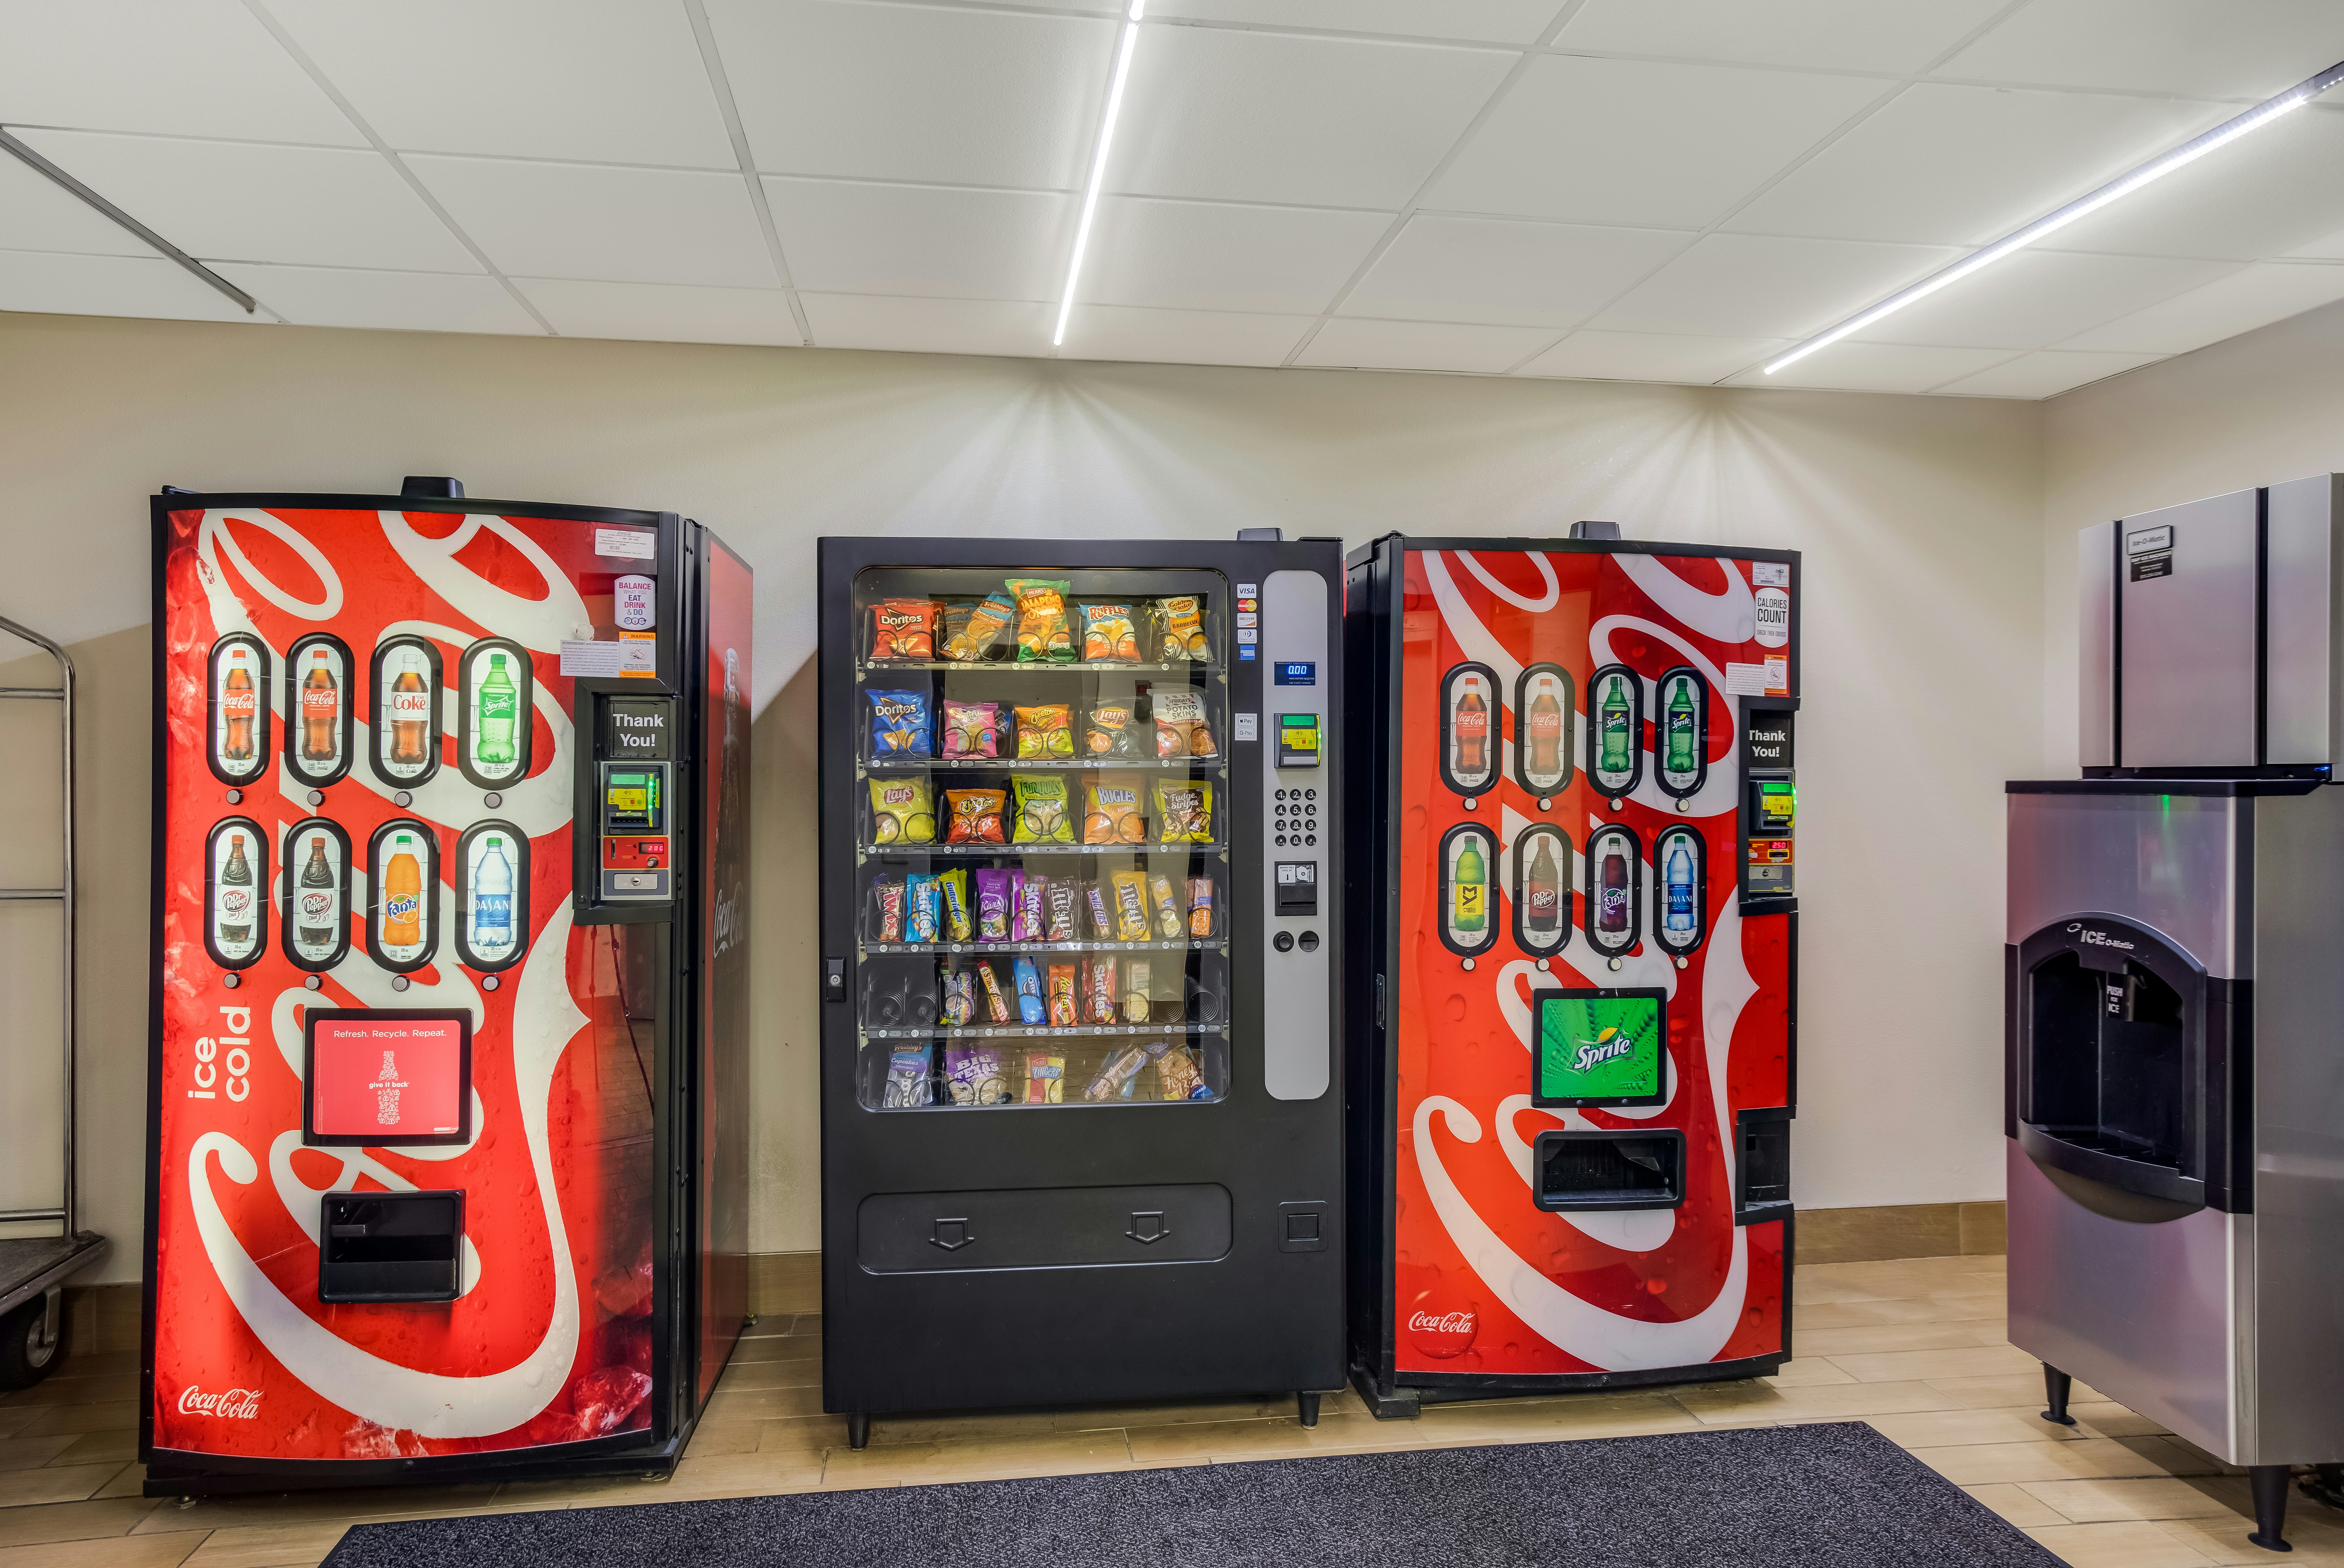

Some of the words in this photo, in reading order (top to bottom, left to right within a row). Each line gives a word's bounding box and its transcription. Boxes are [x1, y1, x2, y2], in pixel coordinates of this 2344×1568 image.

[984, 601, 1010, 612] Freshley's
[1757, 597, 1787, 609] CALORIES
[881, 615, 922, 625] Doritos
[1089, 606, 1129, 620] RUFFLES
[1757, 608, 1787, 624] COUNT
[1172, 620, 1199, 629] BARBECUE
[223, 693, 254, 709] Coca-Cola
[304, 690, 335, 705] Coca-Cola
[393, 694, 426, 710] Coke
[485, 701, 510, 710] Sprite
[875, 704, 916, 716] Doritos
[1166, 705, 1198, 713] POTATO
[613, 714, 664, 727] Thank
[1030, 708, 1055, 725] Cheetos
[1099, 710, 1127, 724] Lay's
[1172, 710, 1196, 719] SKINS
[1458, 712, 1485, 726] Coca-Cola
[1532, 714, 1558, 726] Coca-Cola
[1606, 717, 1625, 728] Sprite
[1673, 718, 1690, 729] Sprite
[620, 734, 655, 747] You!
[1749, 730, 1786, 741] Thank
[1752, 746, 1779, 757] You!
[886, 787, 913, 803] Lay's
[1021, 780, 1062, 797] FUNYUNS
[1096, 786, 1136, 805] BUGLES
[1170, 793, 1197, 801] Fudge
[962, 797, 996, 814] Cheetos
[1171, 799, 1198, 810] Stripes
[226, 895, 248, 909] Pepper
[233, 893, 242, 901] Dr
[313, 896, 323, 904] Dr
[945, 881, 962, 923] Butterfinger
[1533, 893, 1553, 906] Pepper
[1539, 891, 1548, 899] Dr
[1602, 892, 1626, 910] Fanta
[1669, 894, 1692, 903] DASANI
[306, 899, 329, 912] Pepper
[388, 898, 417, 918] Fanta
[476, 897, 511, 912] DASANI
[916, 882, 933, 937] Skittles
[1024, 883, 1040, 936] Skittles
[1090, 891, 1108, 926] SNICKERS
[884, 892, 898, 933] TWIX
[2080, 930, 2106, 945] ICE
[1027, 976, 1036, 999] OREO
[1060, 976, 1071, 1010] Reese's
[1093, 964, 1107, 1017] Skittles
[2107, 985, 2123, 997] PUSH
[2109, 1003, 2119, 1013] ICE
[373, 1029, 409, 1039] Recycle.
[412, 1029, 447, 1039] Repeat.
[220, 1006, 251, 1102] cold
[1574, 1033, 1630, 1072] Sprite
[188, 1037, 216, 1100] ice
[891, 1058, 919, 1066] Cupcakes
[955, 1054, 992, 1071] BIG
[953, 1063, 999, 1083] TEXAS
[1032, 1066, 1062, 1078] ZINGERS
[1165, 1062, 1198, 1090] Honey
[1192, 1085, 1207, 1098] Glazed
[1409, 1311, 1476, 1333] Coca-Cola
[178, 1385, 264, 1419] Coca-Cola
